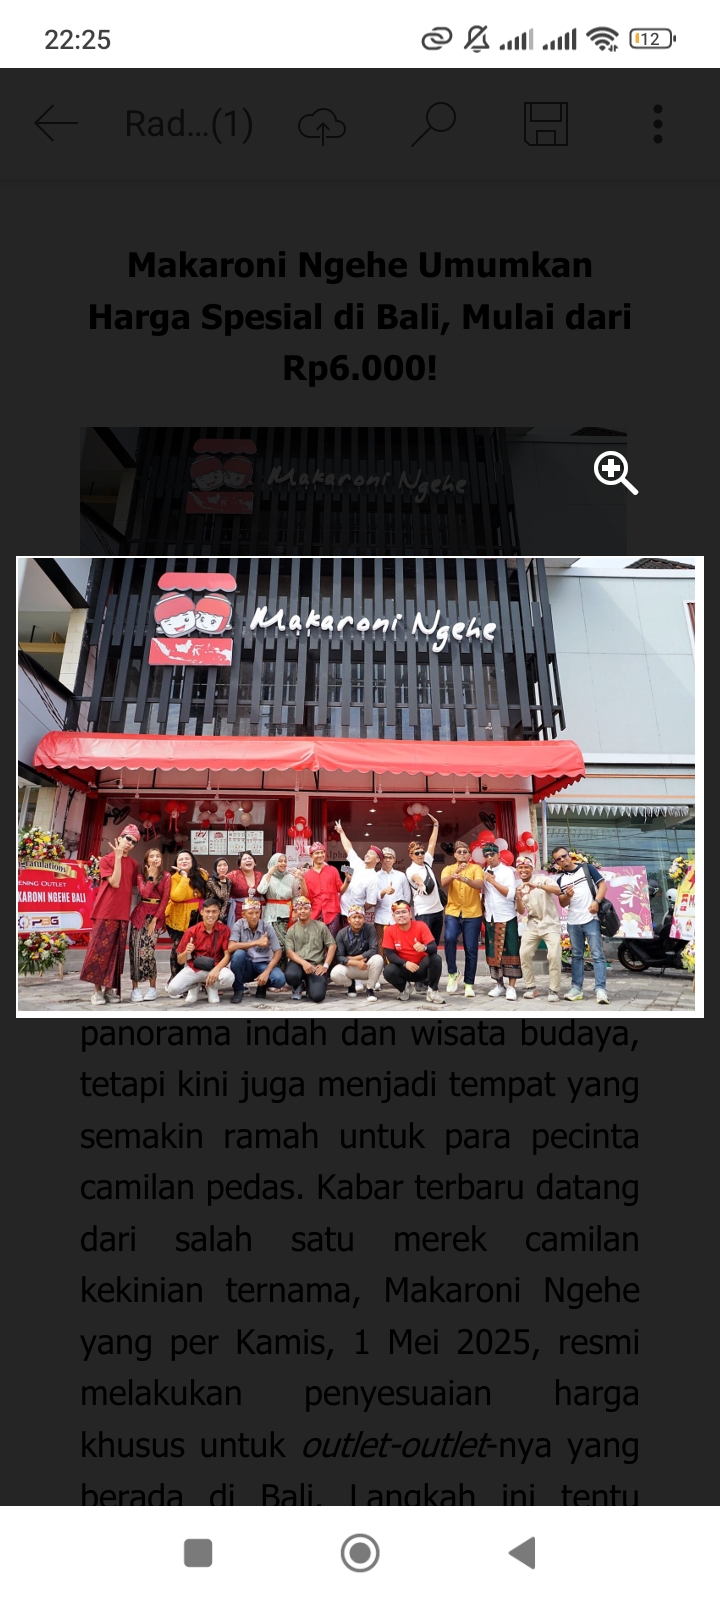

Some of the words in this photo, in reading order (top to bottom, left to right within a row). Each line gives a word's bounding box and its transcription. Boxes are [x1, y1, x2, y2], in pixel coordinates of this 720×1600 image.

[44, 29, 111, 50] 22:25
[641, 32, 659, 46] 12
[129, 251, 285, 278] Makaroni
[300, 251, 407, 284] Ngehe
[420, 251, 591, 278] Umumkan
[90, 304, 189, 336] Harga
[202, 303, 321, 336] Spesial
[334, 303, 363, 330] di
[378, 303, 449, 335] Bali,
[463, 303, 553, 330] Mulai
[566, 303, 630, 330] dari
[284, 355, 435, 387] Rp6.000!
[267, 466, 391, 488] Makaroni
[398, 469, 467, 504] Ngehe
[249, 605, 403, 634] Makaroni
[411, 609, 497, 653] Ngehe
[47, 891, 70, 902] NGEHE
[71, 892, 86, 902] BALI
[82, 1026, 230, 1052] panorama
[247, 1019, 326, 1046] indah
[342, 1019, 395, 1046] dan
[411, 1020, 504, 1046] wisata
[522, 1019, 638, 1052] budaya,
[80, 1071, 164, 1103] tetapi
[179, 1070, 227, 1096] kini
[239, 1071, 304, 1103] juga
[319, 1070, 435, 1103] menjadi
[449, 1072, 555, 1103] tempat
[567, 1077, 638, 1103] yang
[81, 1122, 202, 1149] semakin
[225, 1122, 317, 1149] ramah
[341, 1122, 425, 1149] untuk
[446, 1129, 509, 1155] para
[533, 1123, 638, 1155] pecinta
[81, 1173, 193, 1200] camilan
[208, 1173, 302, 1206] pedas.
[319, 1173, 403, 1200] Kabar
[415, 1173, 523, 1200] terbaru
[537, 1173, 638, 1206] datang
[81, 1225, 135, 1252] dari
[176, 1225, 251, 1252] salah
[292, 1227, 353, 1252] satu
[395, 1225, 487, 1252] merek
[526, 1225, 638, 1252] camilan
[82, 1276, 202, 1303] kekinian
[226, 1278, 360, 1308] ternama,
[386, 1276, 519, 1303] Makaroni
[546, 1276, 639, 1309] Ngehe
[80, 1335, 151, 1361] yang
[172, 1335, 219, 1361] per
[238, 1329, 333, 1360] Kamis,
[356, 1329, 368, 1354] 1
[390, 1329, 438, 1355] Mei
[458, 1329, 539, 1360] 2025,
[560, 1329, 638, 1355] resmi
[82, 1379, 241, 1406] melakukan
[306, 1380, 490, 1412] penyesuaian
[556, 1379, 638, 1412] harga
[82, 1431, 184, 1458] khusus
[201, 1431, 286, 1458] untuk
[303, 1431, 550, 1464] outlet-outlet-nya
[567, 1438, 638, 1464] yang
[82, 1483, 182, 1506] berada
[210, 1483, 234, 1506] di
[503, 1483, 534, 1506] ini
[561, 1485, 638, 1506] tentu
